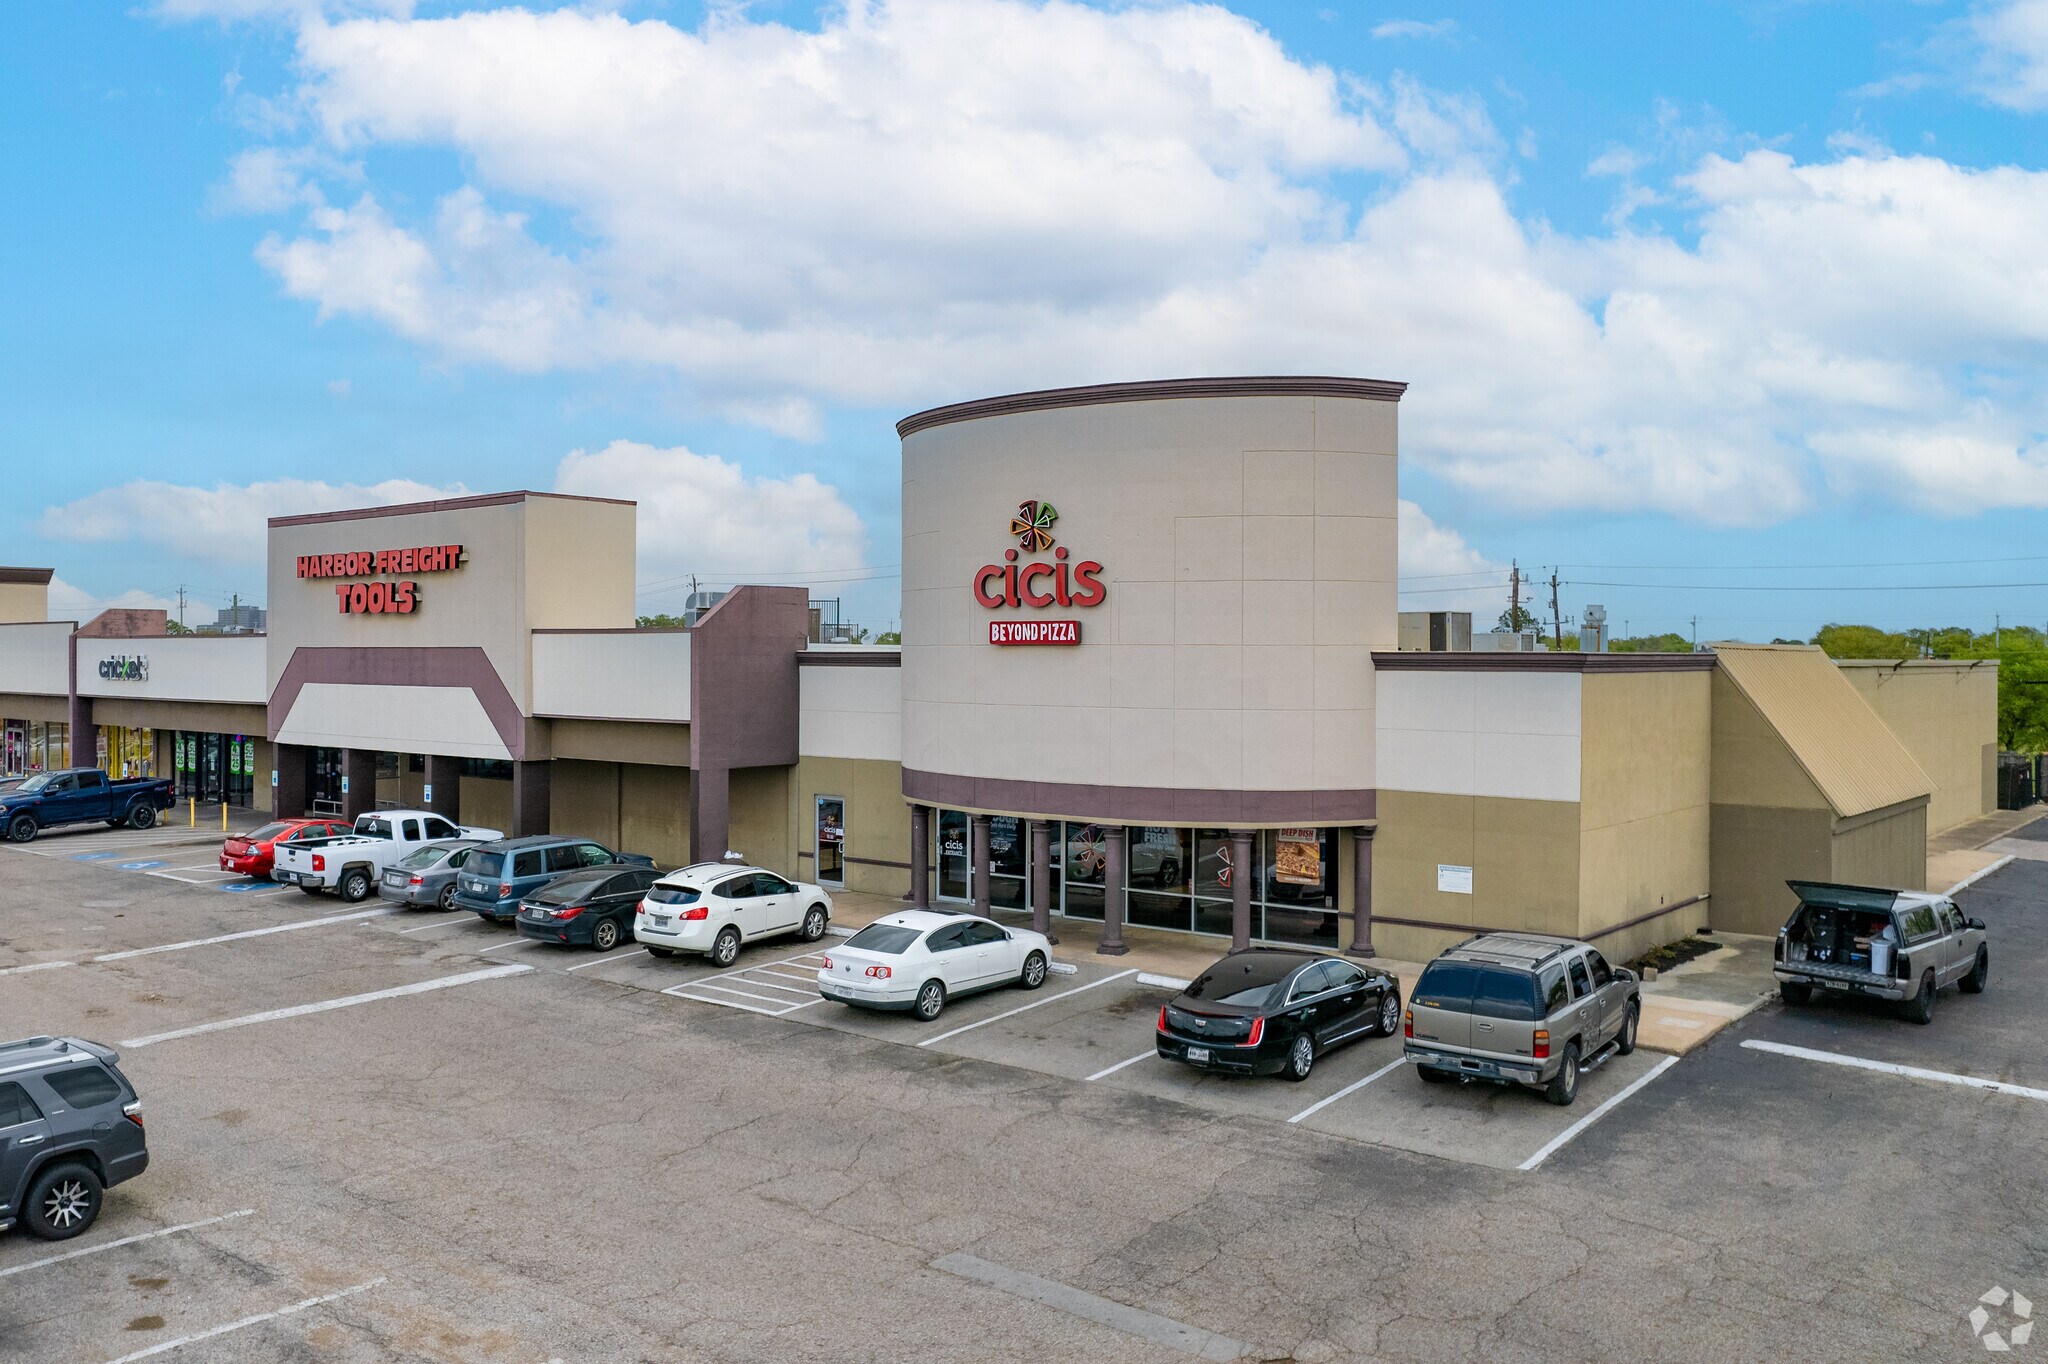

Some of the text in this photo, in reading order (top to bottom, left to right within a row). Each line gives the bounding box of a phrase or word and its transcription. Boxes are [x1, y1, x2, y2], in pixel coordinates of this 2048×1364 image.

[297, 544, 464, 579] HARBOR FREIGHT
[973, 546, 1107, 609] cicis
[336, 581, 417, 614] TOOLS
[991, 622, 1077, 642] BEYOND PIZZA
[98, 655, 143, 681] cricket
[945, 839, 963, 850] cicis
[1281, 828, 1314, 838] DEEP DISH
